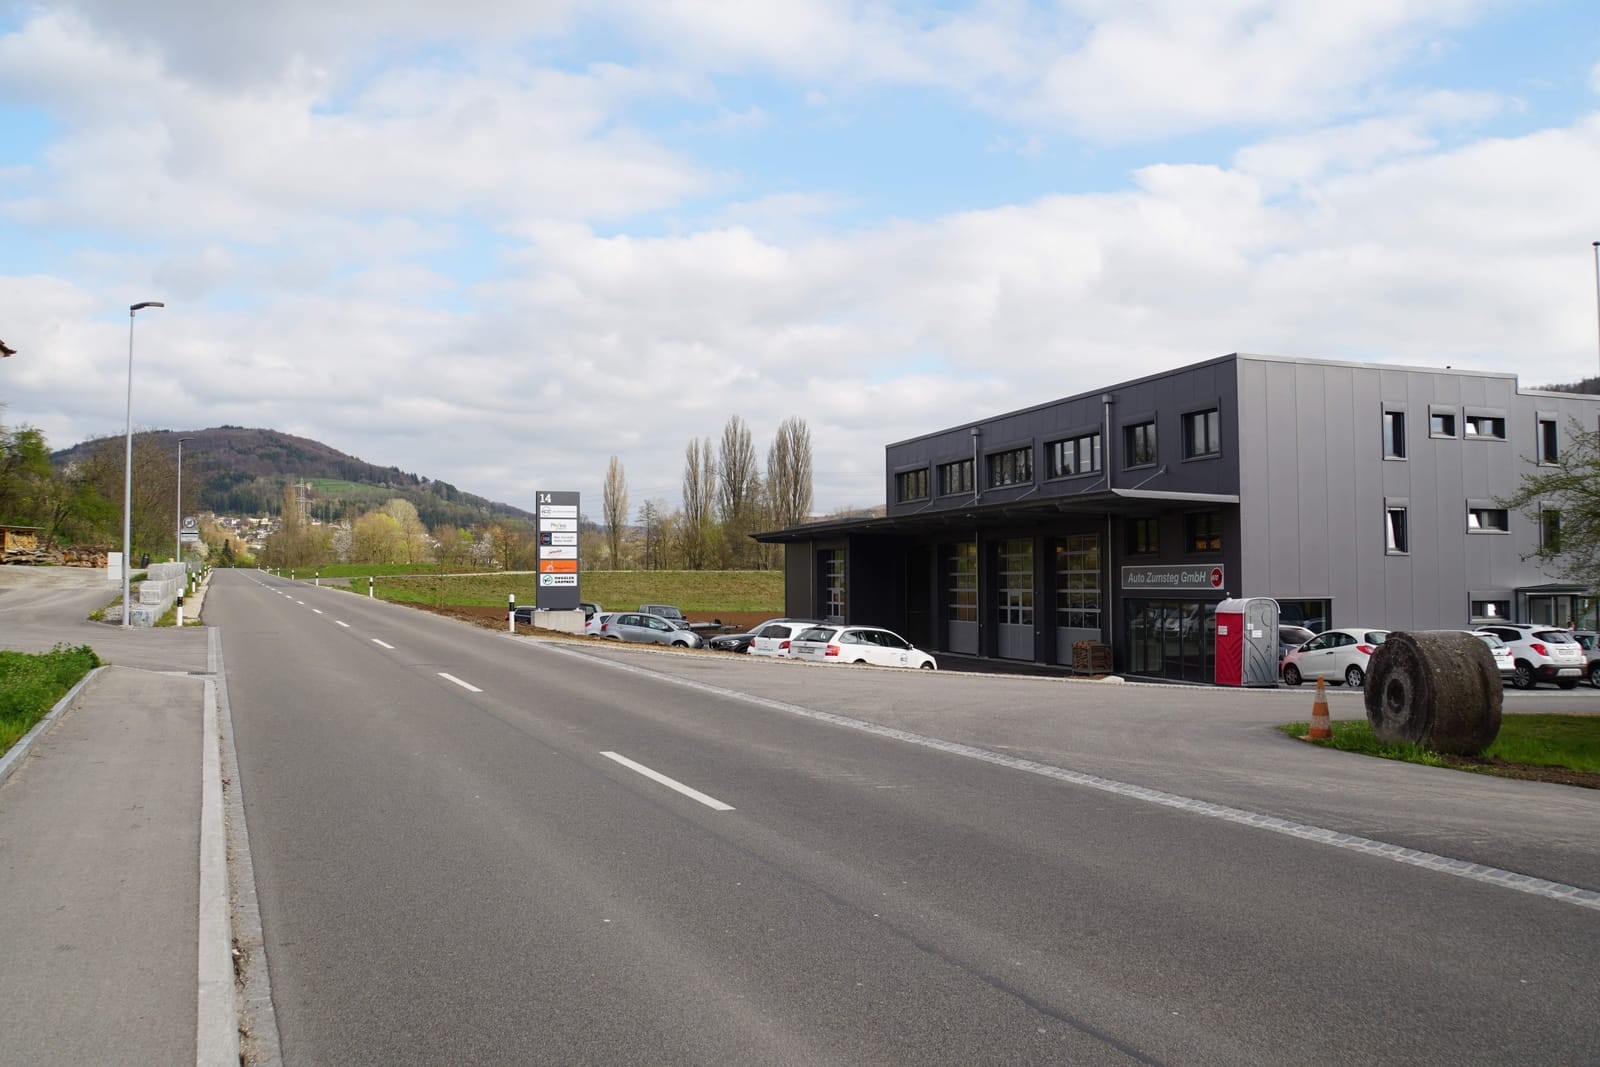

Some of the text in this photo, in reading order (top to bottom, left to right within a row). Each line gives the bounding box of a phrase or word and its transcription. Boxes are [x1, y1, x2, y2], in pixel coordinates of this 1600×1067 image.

[540, 493, 552, 503] 14
[1128, 572, 1145, 583] Auto
[1146, 571, 1178, 585] Zumsteg
[1180, 571, 1206, 583] GmbH
